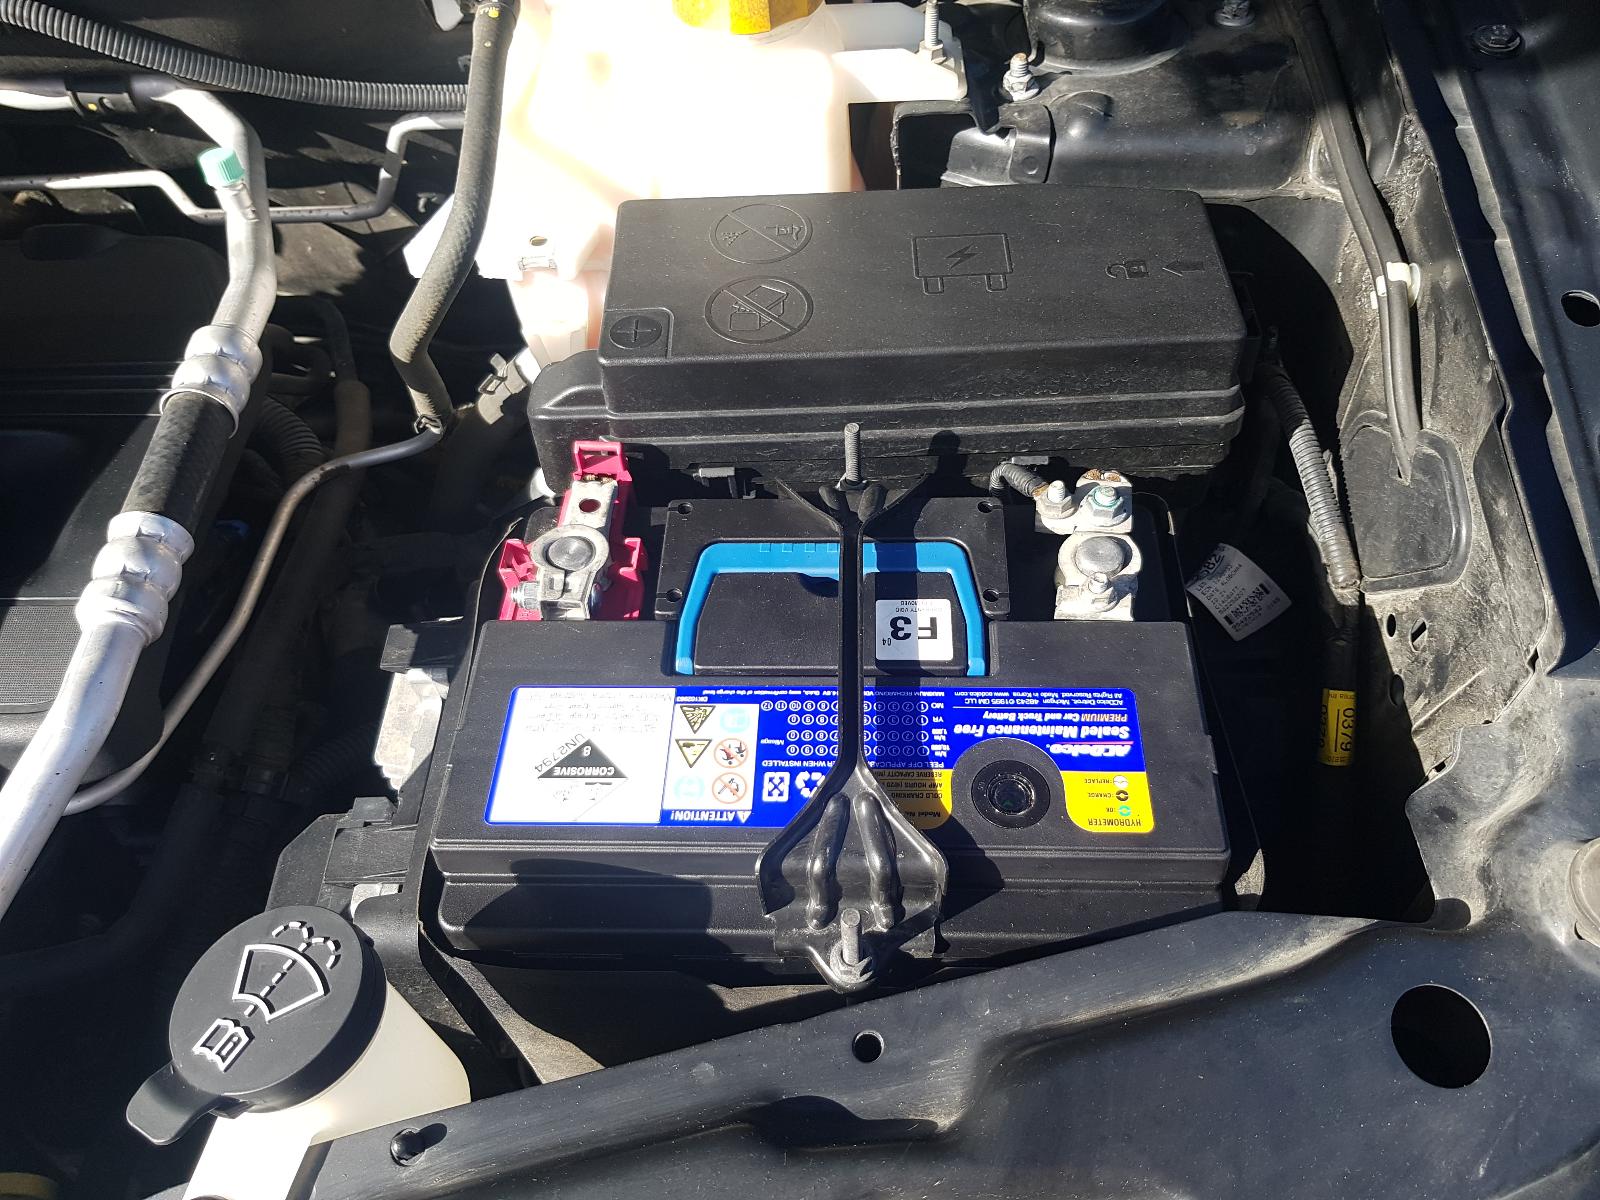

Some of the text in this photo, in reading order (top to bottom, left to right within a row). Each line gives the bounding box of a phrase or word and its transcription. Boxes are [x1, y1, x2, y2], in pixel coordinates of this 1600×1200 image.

[982, 711, 1128, 722] PREMIUM Car and Truck Battery
[953, 724, 1130, 740] Sealed Maintenance Free
[534, 733, 585, 773] UN2794
[583, 745, 592, 757] 8
[1050, 744, 1131, 757] ACDelco
[553, 766, 615, 776] CORROSIVE
[671, 811, 736, 821] ATTENTION!
[1088, 818, 1141, 827] HYDROMETER
